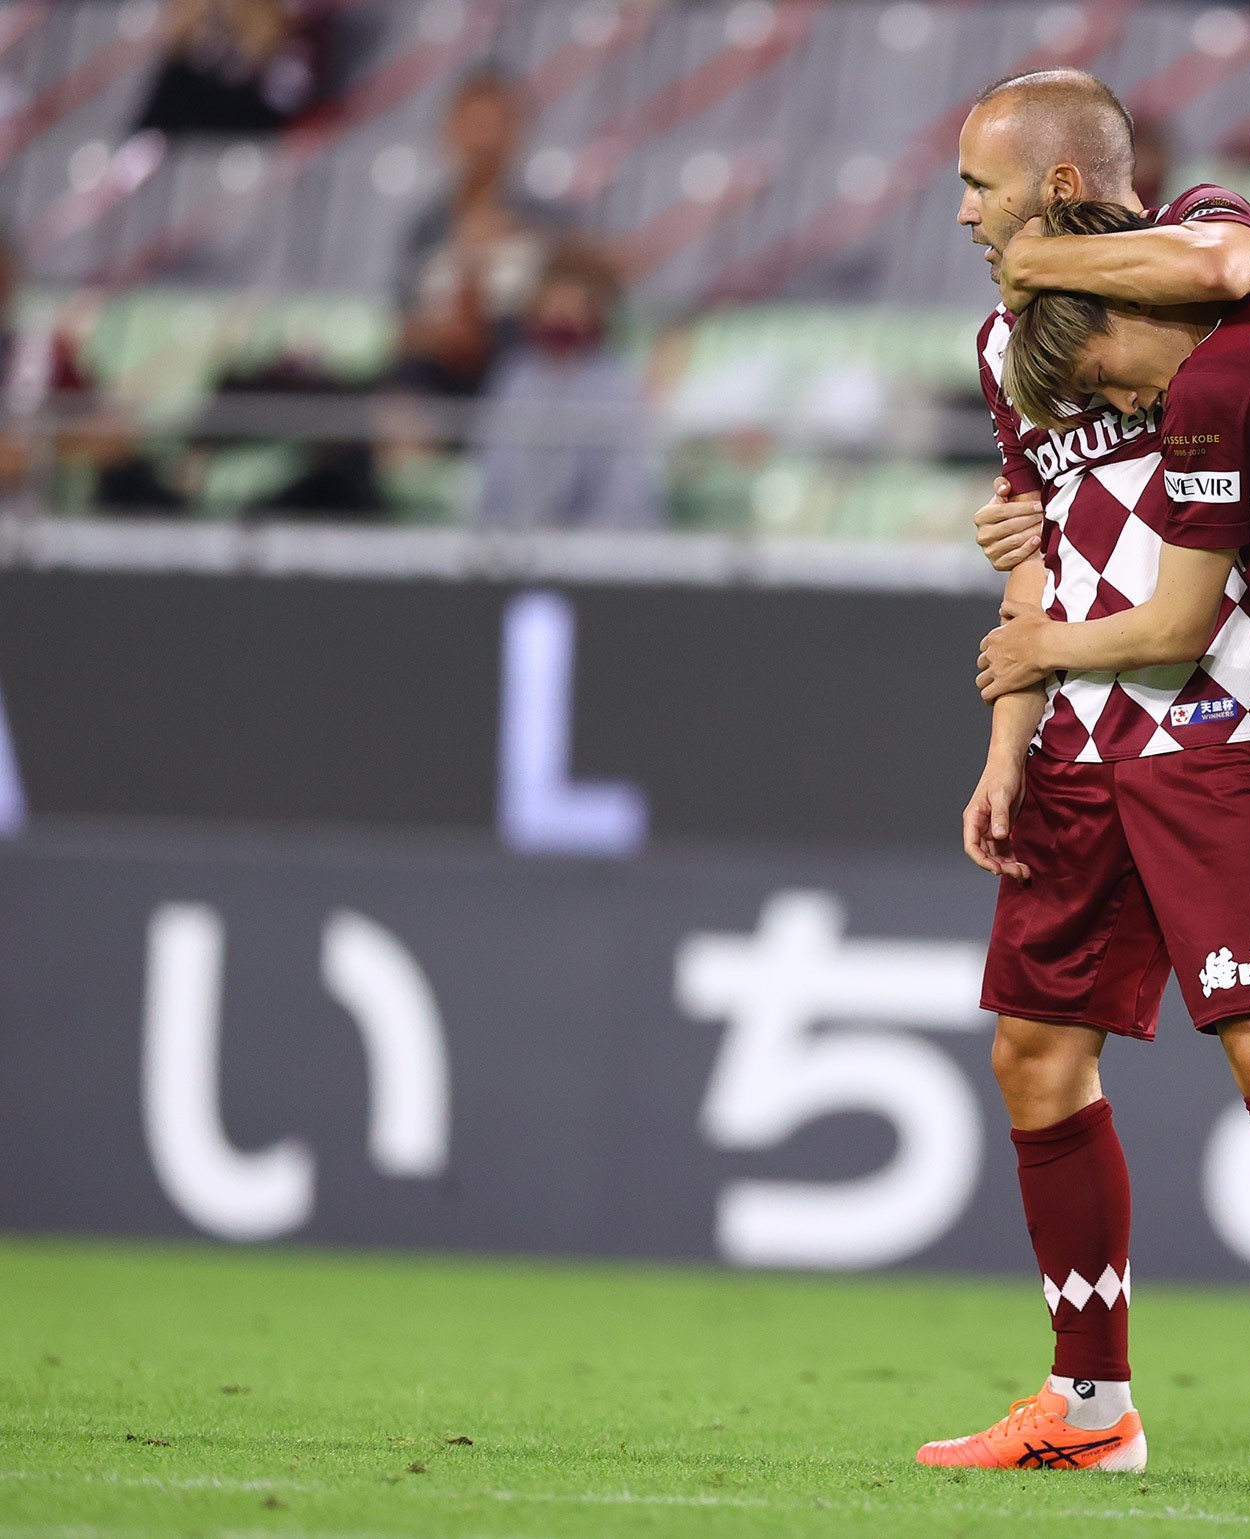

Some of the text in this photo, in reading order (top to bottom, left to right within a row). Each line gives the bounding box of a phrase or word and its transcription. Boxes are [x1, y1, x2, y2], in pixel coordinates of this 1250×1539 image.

[1191, 434, 1221, 444] KOBE
[1200, 699, 1234, 714] 天皇杯
[1201, 710, 1235, 721] WINNERS
